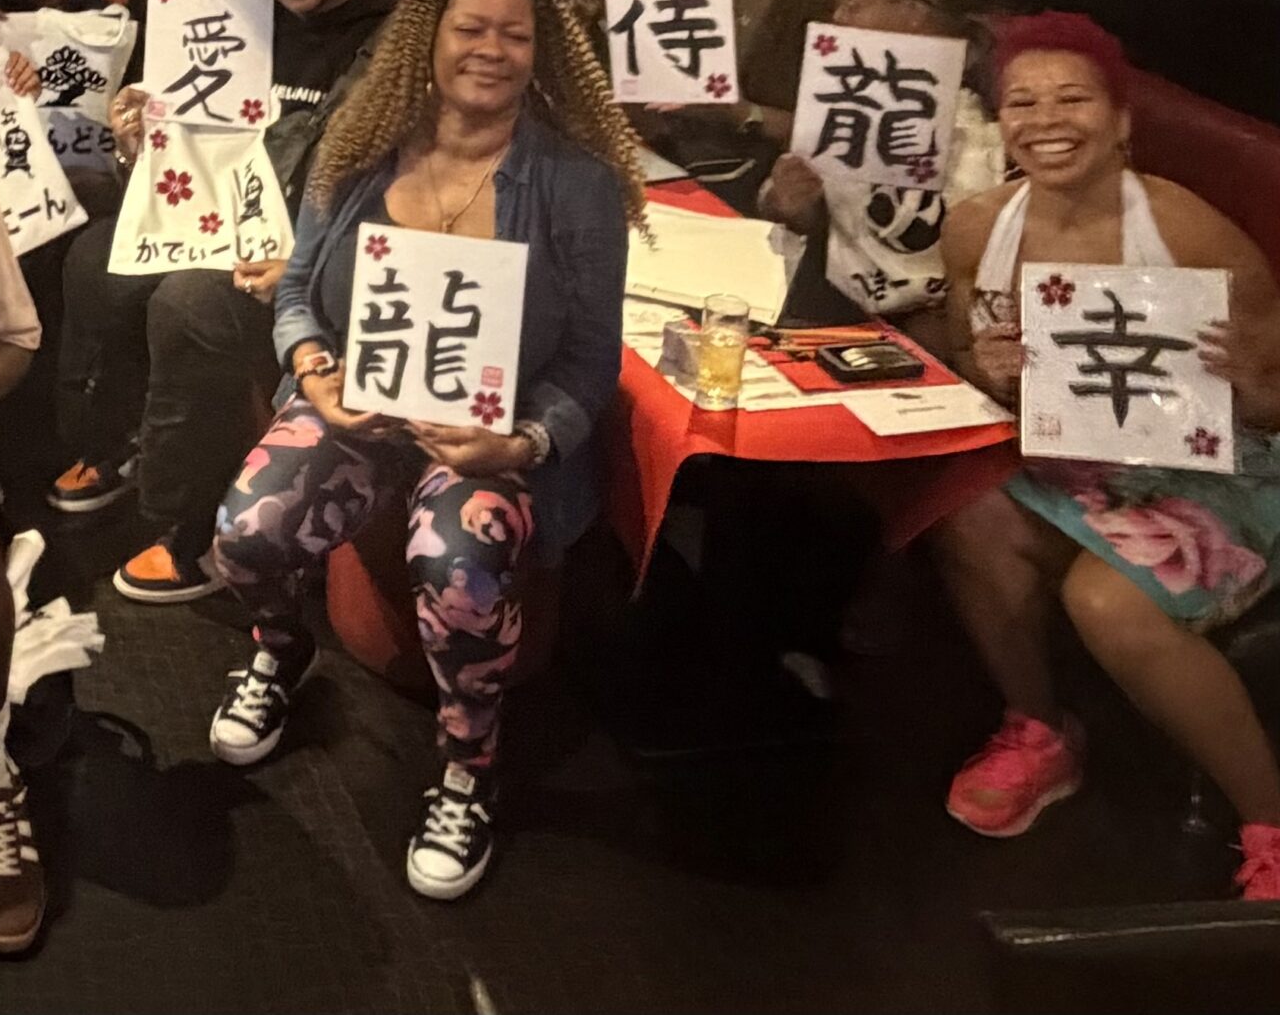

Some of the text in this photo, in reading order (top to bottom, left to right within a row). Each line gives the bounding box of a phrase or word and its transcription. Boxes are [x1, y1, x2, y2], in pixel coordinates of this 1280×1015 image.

[162, 9, 248, 124] 愛
[808, 47, 939, 169] 龍
[354, 266, 483, 403] 龍
[1049, 288, 1198, 429] 幸
